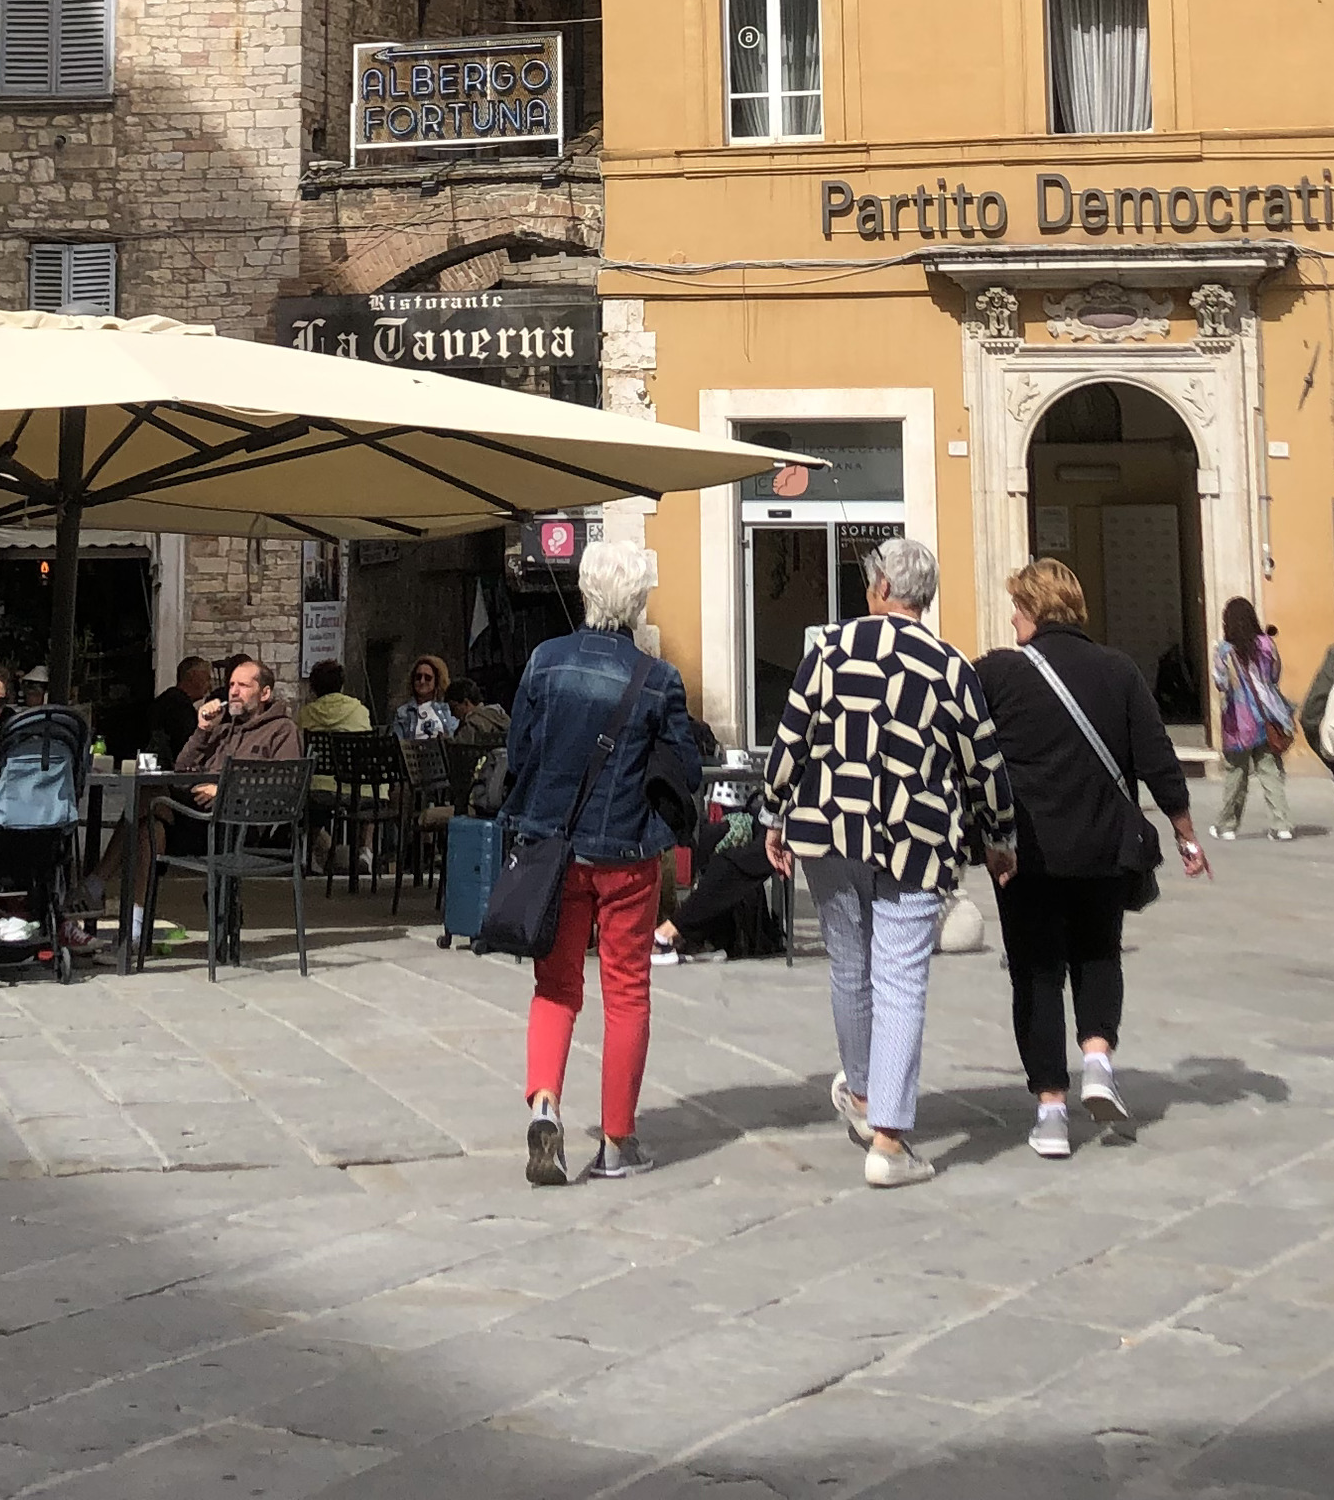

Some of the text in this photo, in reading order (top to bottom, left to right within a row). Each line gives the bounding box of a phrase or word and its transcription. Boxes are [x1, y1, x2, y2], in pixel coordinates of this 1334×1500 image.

[361, 59, 550, 100] ALBERGO
[365, 98, 548, 138] FORTUNA
[821, 176, 1008, 241] Partito
[368, 293, 503, 312] Ristorante
[373, 317, 574, 362] Taverna
[841, 525, 900, 537] SOFFICE
